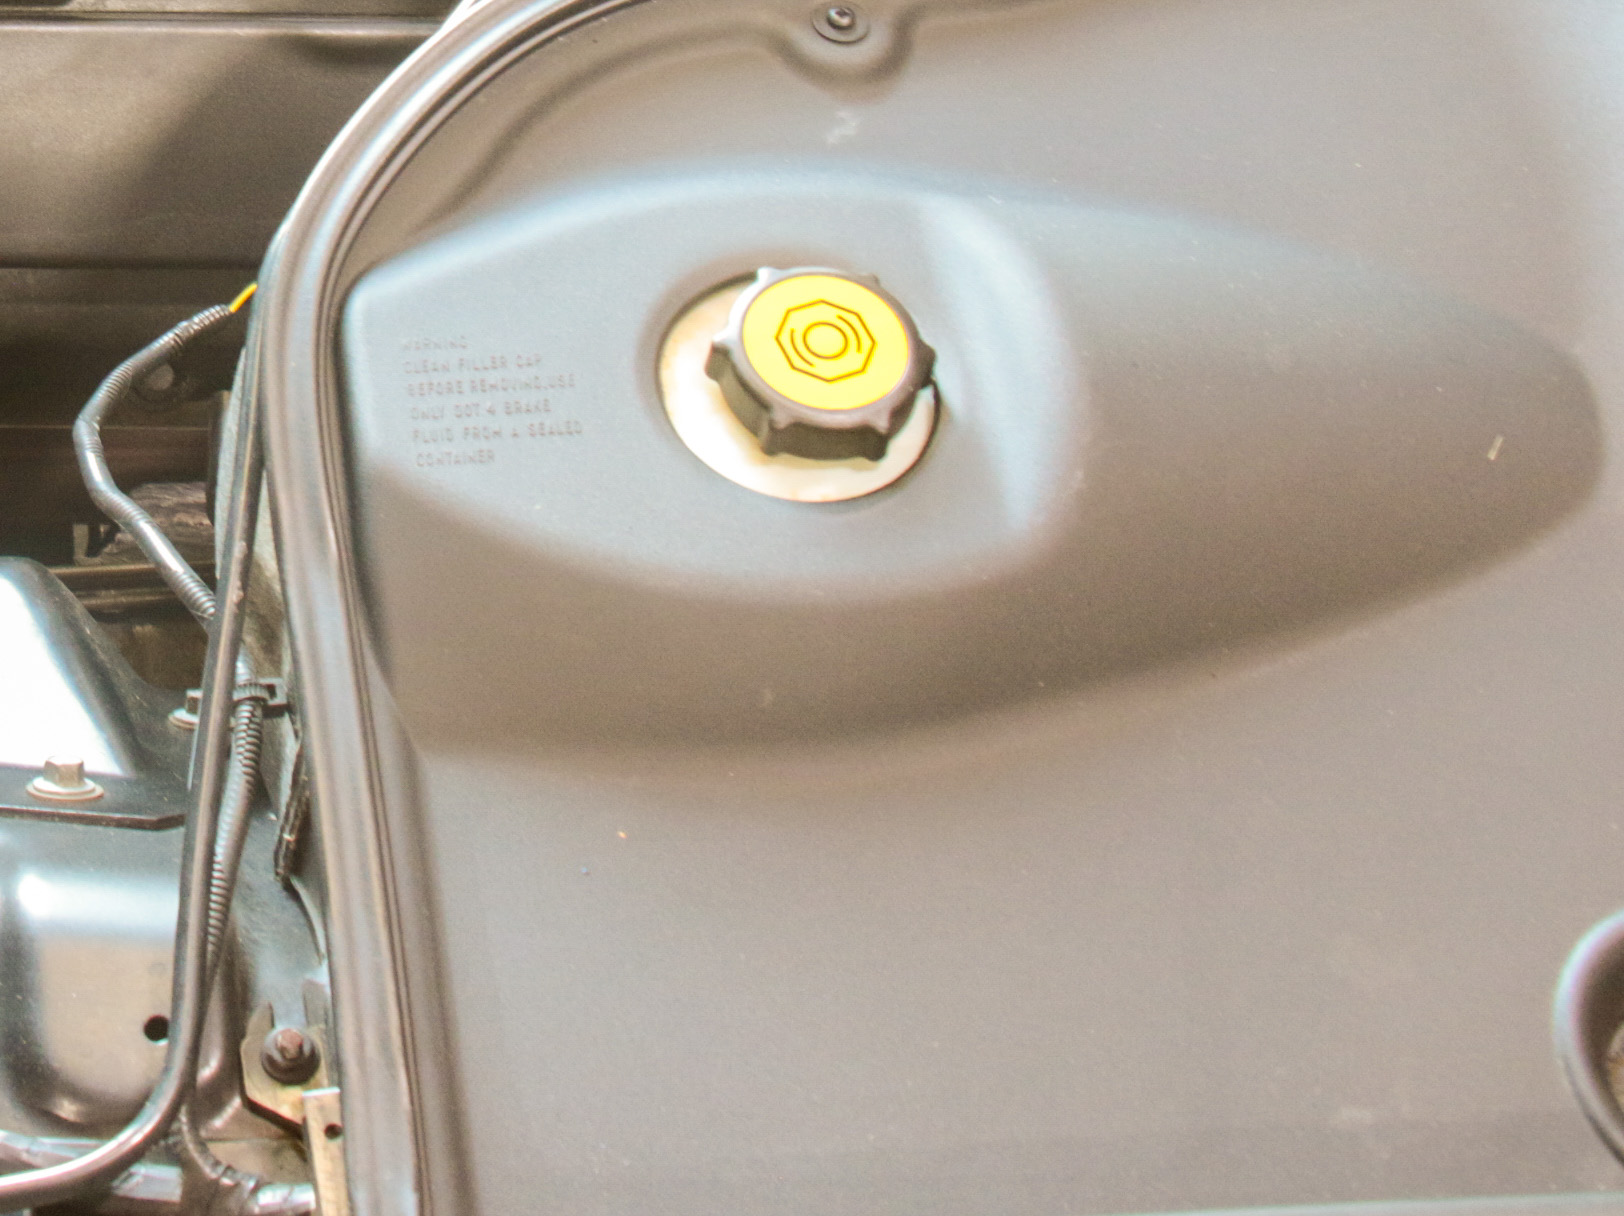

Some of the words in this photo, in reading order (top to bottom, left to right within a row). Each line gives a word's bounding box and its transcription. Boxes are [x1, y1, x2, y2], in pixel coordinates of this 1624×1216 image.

[458, 355, 508, 372] FILLER
[516, 353, 543, 369] CAP
[407, 380, 464, 397] BEFORE
[504, 398, 552, 416] BRAKE
[413, 427, 455, 444] FLUID
[463, 425, 502, 441] FROM
[529, 420, 582, 438] SEALED
[416, 448, 496, 467] CONTAINER
